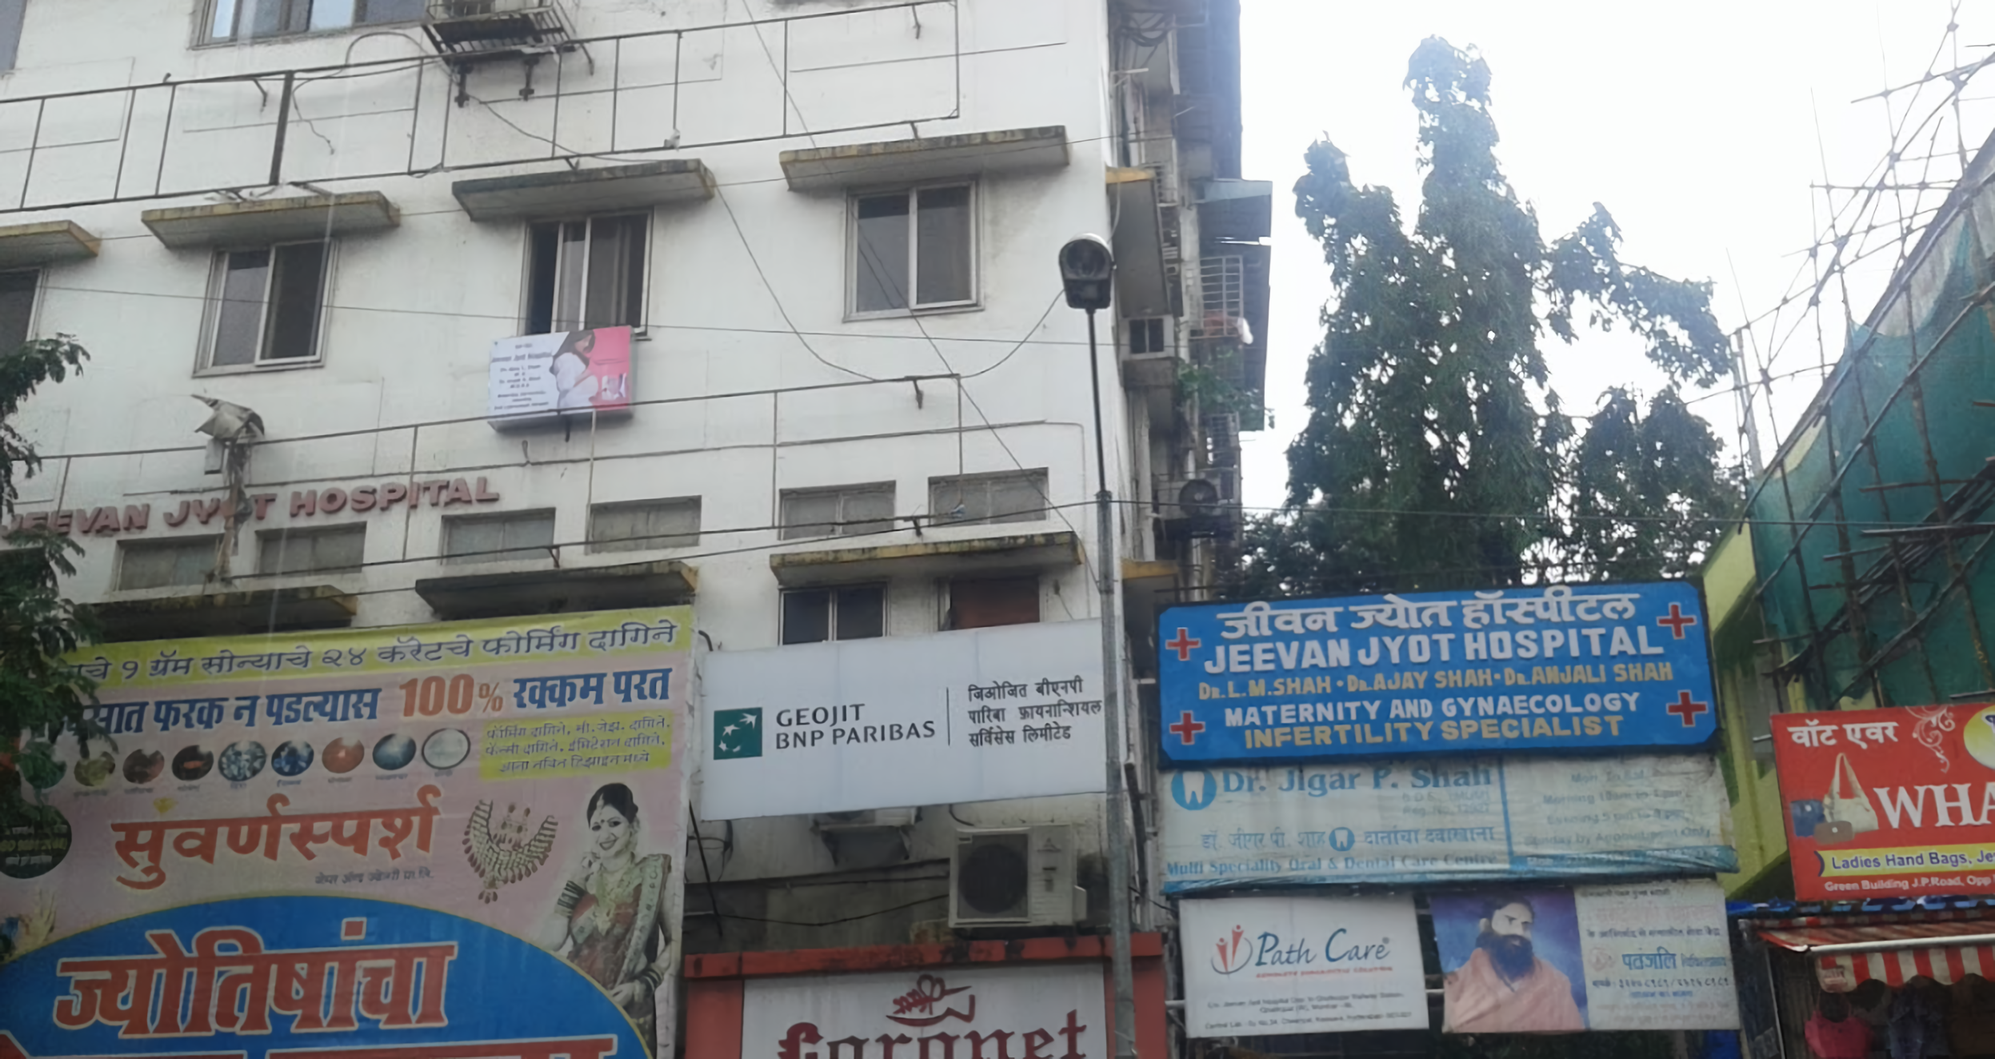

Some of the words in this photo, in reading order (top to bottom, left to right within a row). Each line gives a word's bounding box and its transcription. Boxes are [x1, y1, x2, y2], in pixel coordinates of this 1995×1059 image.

[164, 493, 278, 527] JYT
[290, 477, 499, 518] HOSPITAL
[1216, 601, 1344, 640] जीवन
[1349, 593, 1458, 629] ज्योत
[1461, 585, 1641, 629] हॉस्पीटल
[201, 645, 314, 675] सोन्याचे
[321, 647, 367, 667] २४
[589, 619, 678, 651] दागिने
[1204, 638, 1350, 674] JEEVAN
[1357, 633, 1455, 666] JYOT
[1464, 626, 1664, 660] HOSPITAL
[1034, 675, 1083, 697] बीएनपी
[1613, 662, 1674, 682] SHAH
[154, 697, 230, 731] फरक
[233, 695, 260, 727] न
[266, 688, 382, 726] पडल्यास
[399, 673, 504, 717] 100%
[513, 672, 607, 709] रक्कम
[613, 667, 673, 703] परत
[776, 703, 866, 727] GEOJIT
[968, 705, 1006, 724] पारिबा
[1225, 700, 1381, 727] MATERNITY
[1389, 699, 1433, 719] AND
[1441, 692, 1640, 717] GYNAECOLOGY
[775, 730, 825, 750] BNP
[832, 720, 936, 746] PARIBAS
[1245, 721, 1434, 749] INFERTILITY
[1440, 715, 1624, 740] SPECIALIST
[1787, 718, 1839, 748] वॉट
[1842, 721, 1899, 750] एवर
[1223, 769, 1267, 793] Dr.
[1373, 763, 1398, 789] P.
[110, 784, 441, 890] सुवर्णस्पर्श
[1328, 857, 1338, 870] &
[1832, 855, 1881, 869] Ladies
[1885, 853, 1924, 867] Hand
[1929, 851, 1973, 868] Bags,
[1976, 850, 1995, 863] Je
[1824, 881, 1860, 892] Green
[1861, 879, 1909, 891] Building
[1255, 931, 1317, 966] Path
[53, 917, 458, 1038] ज्योतिषांचा
[778, 1008, 1087, 1059] Coronet
